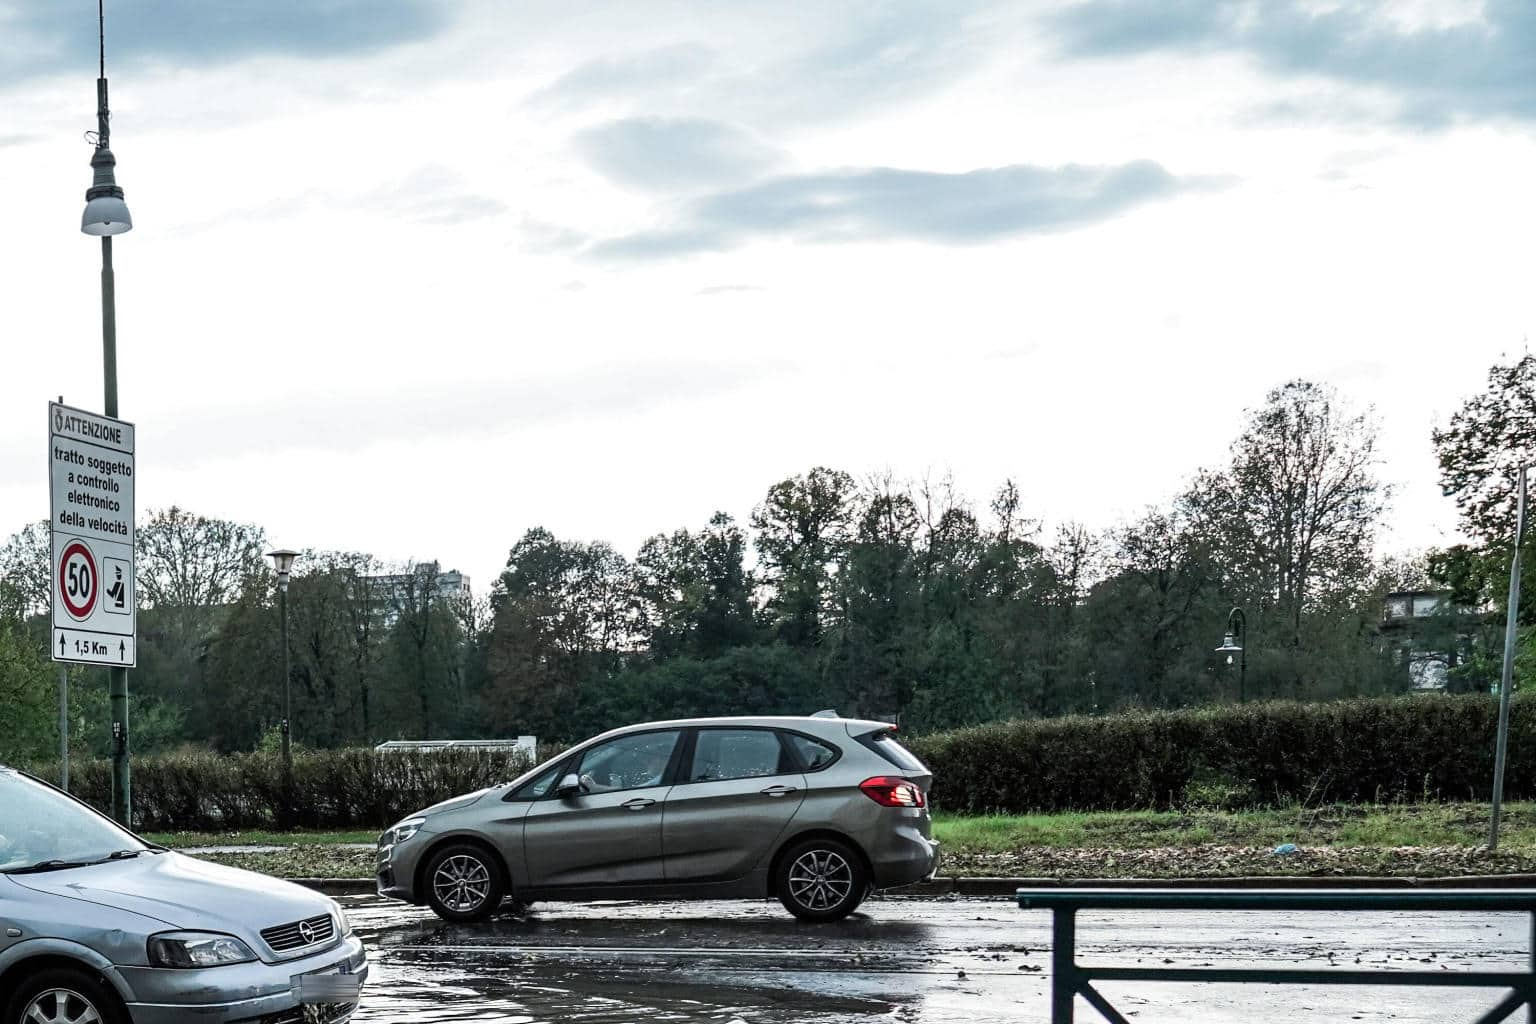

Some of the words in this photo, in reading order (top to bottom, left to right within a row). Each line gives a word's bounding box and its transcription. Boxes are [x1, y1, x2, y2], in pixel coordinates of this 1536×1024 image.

[64, 416, 121, 444] ATTENZIONE
[54, 446, 84, 465] tratto
[87, 457, 131, 477] soggetto
[68, 472, 74, 483] a
[77, 474, 119, 493] controllo
[68, 489, 120, 512] elettronico
[60, 510, 84, 528] della
[88, 517, 127, 536] velocità
[68, 562, 90, 598] 50
[75, 640, 89, 656] 1,5
[92, 641, 107, 656] Km
